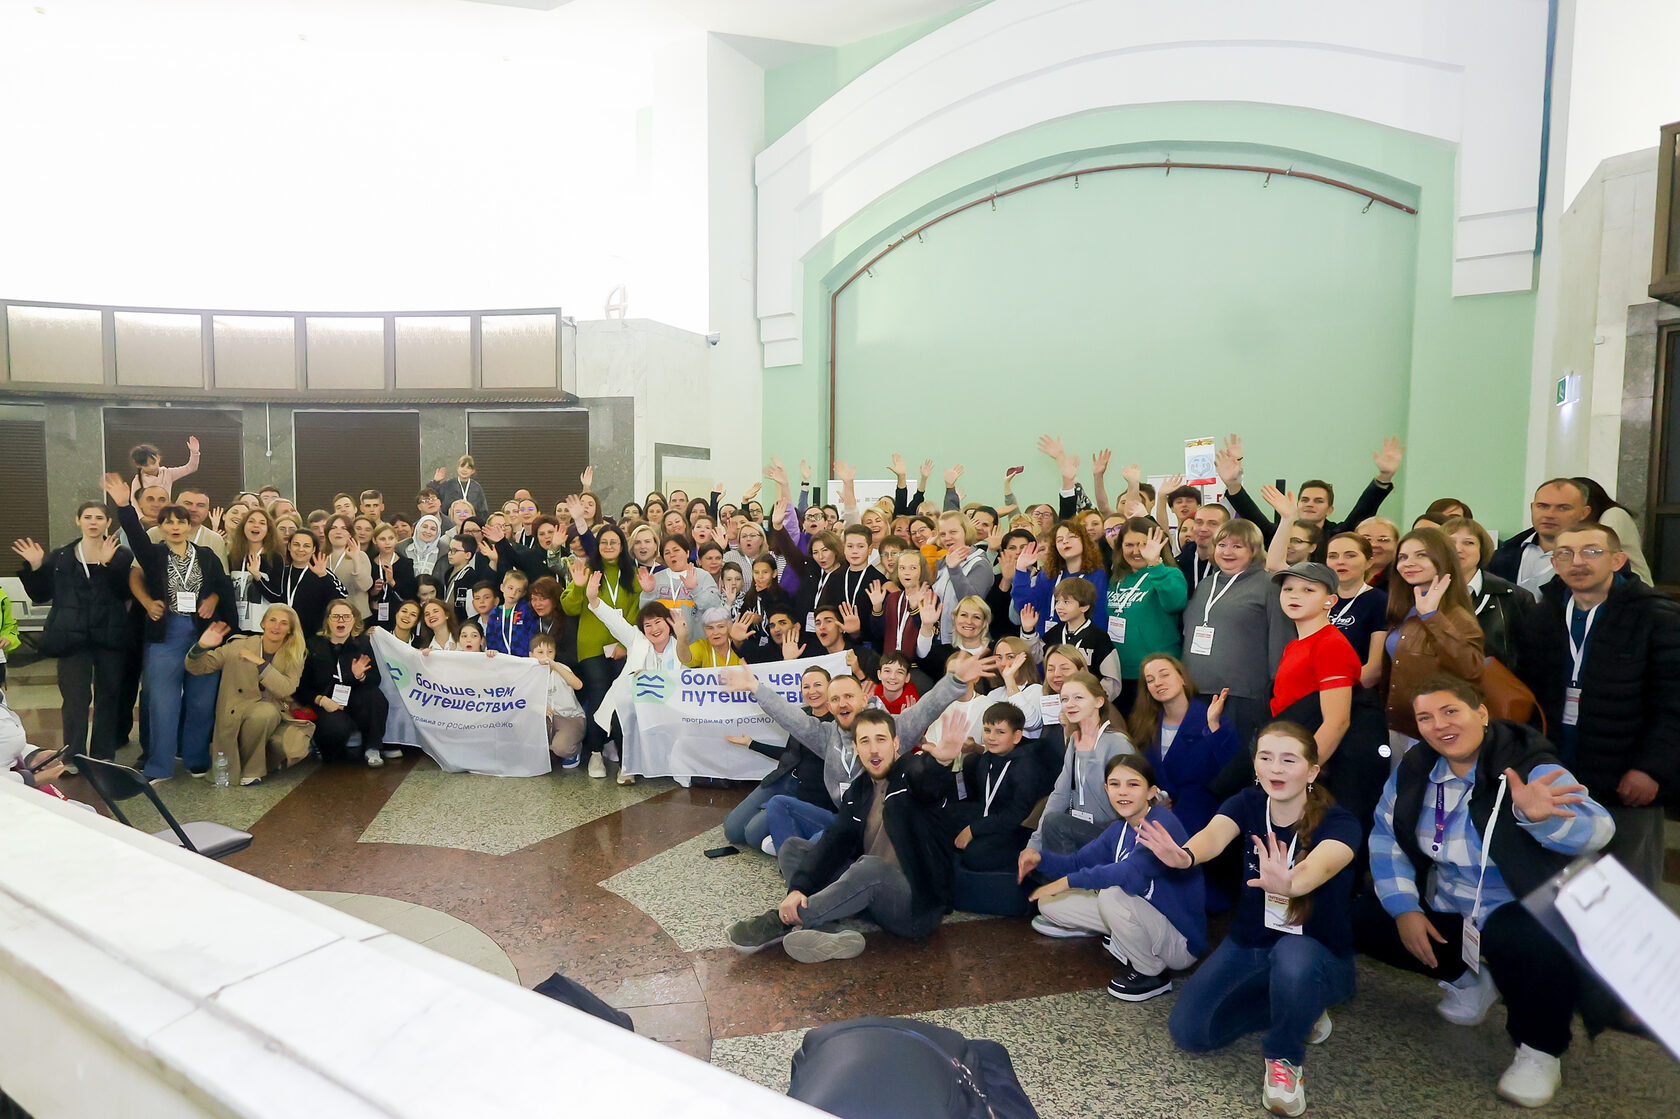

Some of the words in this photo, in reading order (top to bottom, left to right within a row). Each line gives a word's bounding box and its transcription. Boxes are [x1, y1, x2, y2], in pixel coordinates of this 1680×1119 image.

[415, 673, 481, 698] больше,
[483, 686, 516, 698] чем
[408, 688, 527, 713] путешествие
[681, 717, 723, 725] программа
